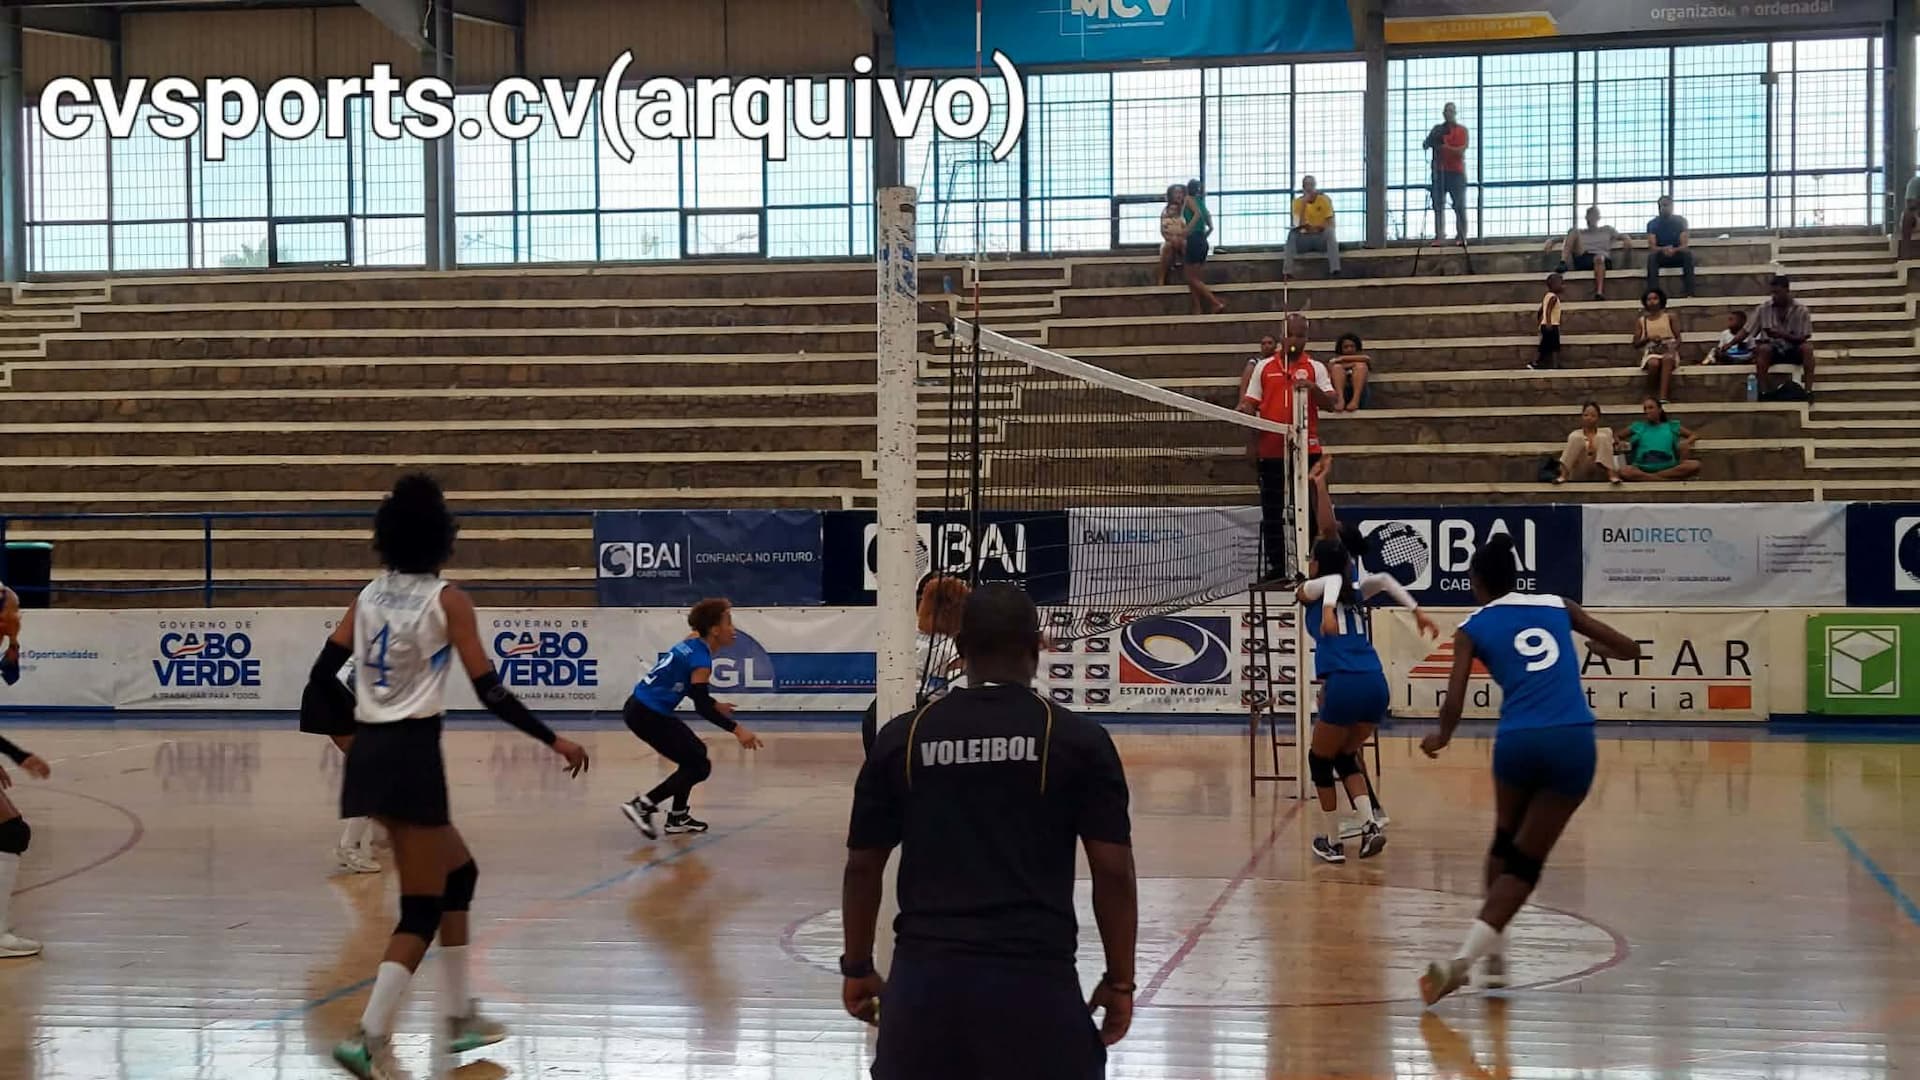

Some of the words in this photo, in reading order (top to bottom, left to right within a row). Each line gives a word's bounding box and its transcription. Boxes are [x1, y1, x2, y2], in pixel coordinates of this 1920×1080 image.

[1439, 518, 1536, 572] BAI
[1603, 528, 1712, 543] BAIDIRECTO
[636, 542, 680, 568] BAI
[696, 553, 752, 563] CONFIANÇA
[755, 553, 770, 562] NO
[1440, 578, 1471, 591] CAB
[160, 621, 226, 629] GOVERNO
[236, 621, 251, 629] DE
[494, 620, 562, 628] GOVERNO
[571, 620, 588, 628] DE
[161, 633, 251, 659] CABO
[365, 620, 391, 687] 4
[494, 632, 588, 659] CABO
[1514, 627, 1559, 672] 9
[152, 659, 261, 686] VERDE
[488, 659, 598, 686] VERDE
[1120, 687, 1166, 695] ESTADIO
[1170, 687, 1228, 695] NACIONAL
[921, 736, 1039, 766] VOLEIBOL
